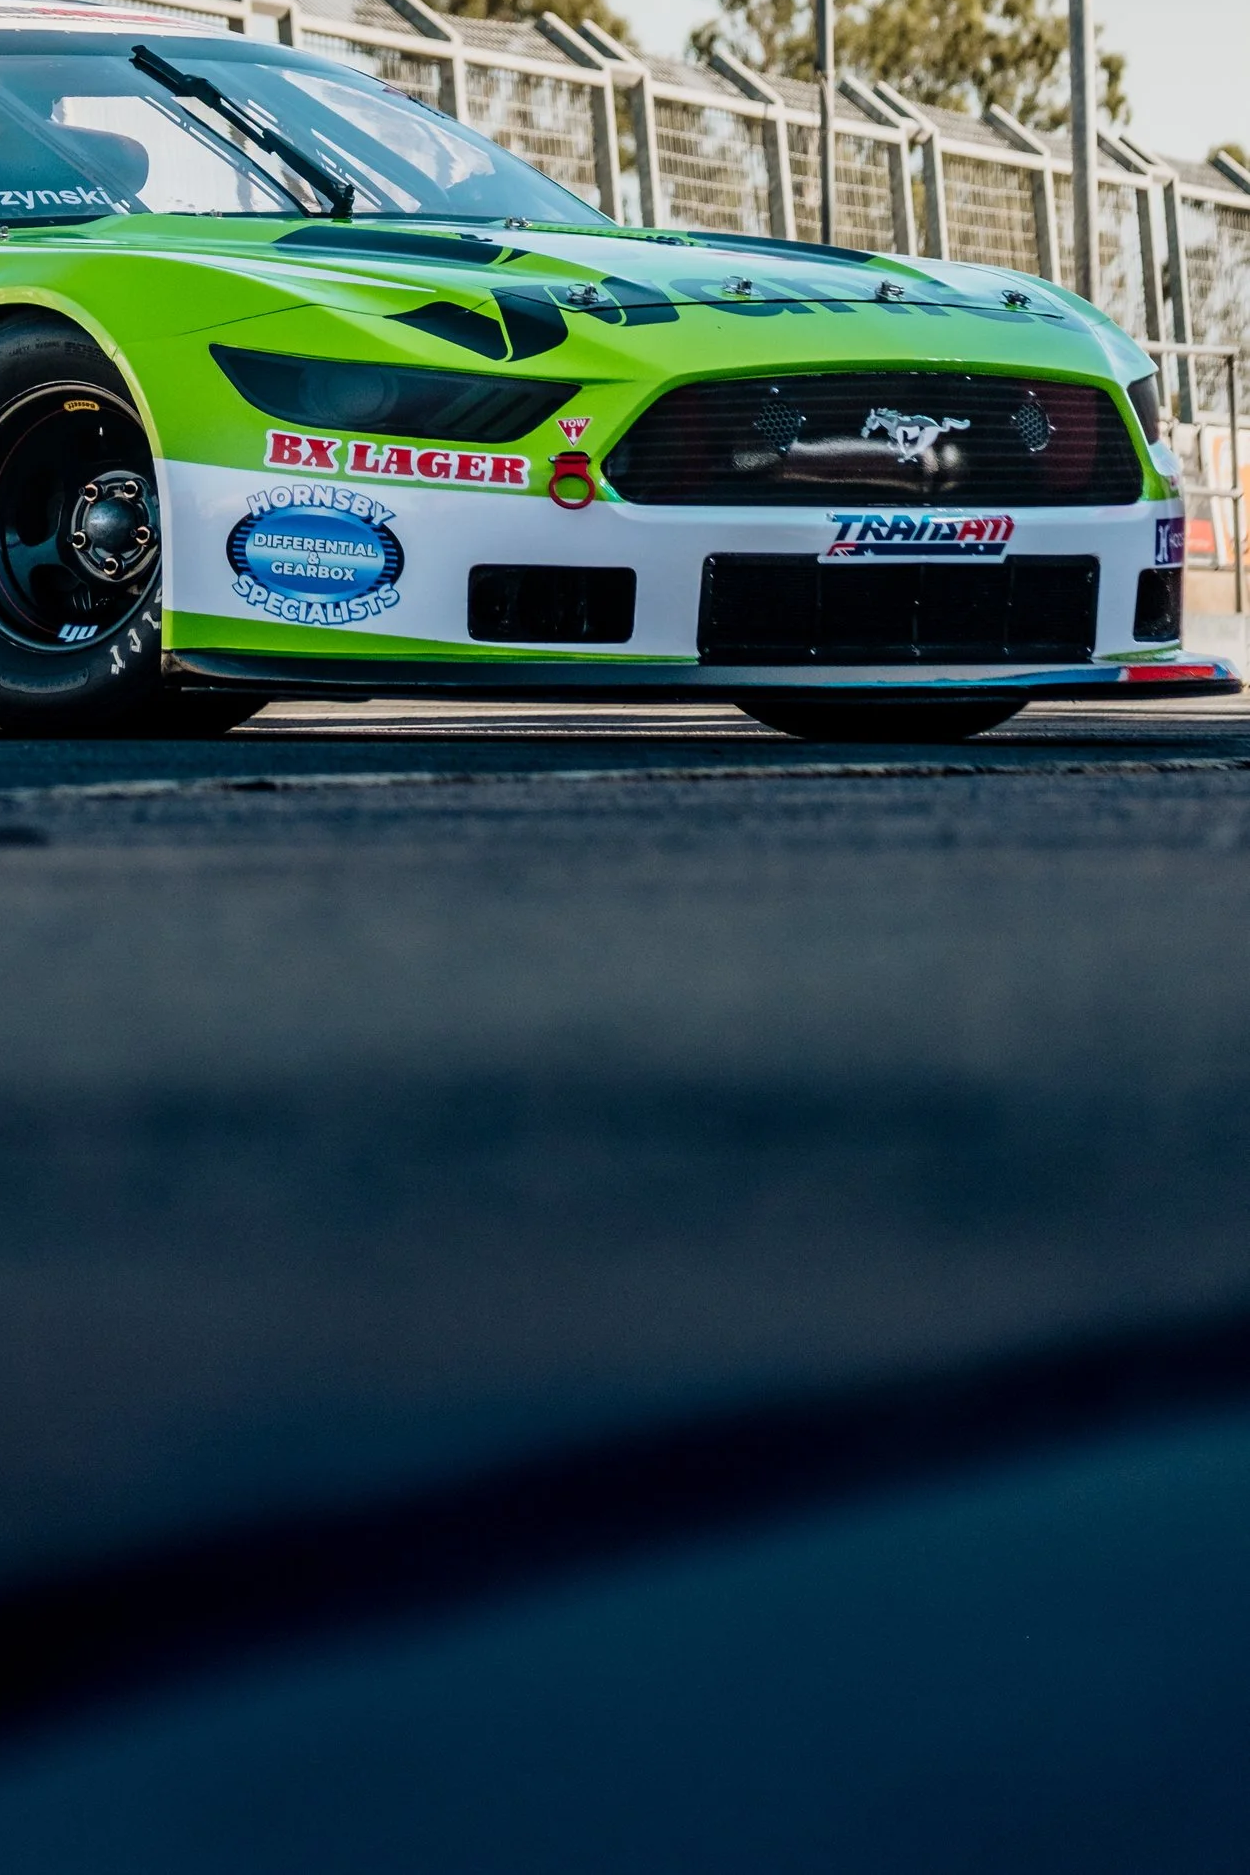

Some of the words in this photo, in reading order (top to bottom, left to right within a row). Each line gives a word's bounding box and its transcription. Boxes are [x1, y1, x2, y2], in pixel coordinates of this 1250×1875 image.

[559, 418, 588, 429] TOW
[267, 432, 337, 470] BX
[349, 442, 527, 486] LAGER
[247, 484, 397, 527] HORNSBY
[253, 532, 378, 559] DIFFERENTIAL
[307, 550, 320, 566] &
[270, 559, 356, 583] GEARBOX
[232, 574, 400, 626] SPECIALISTS
